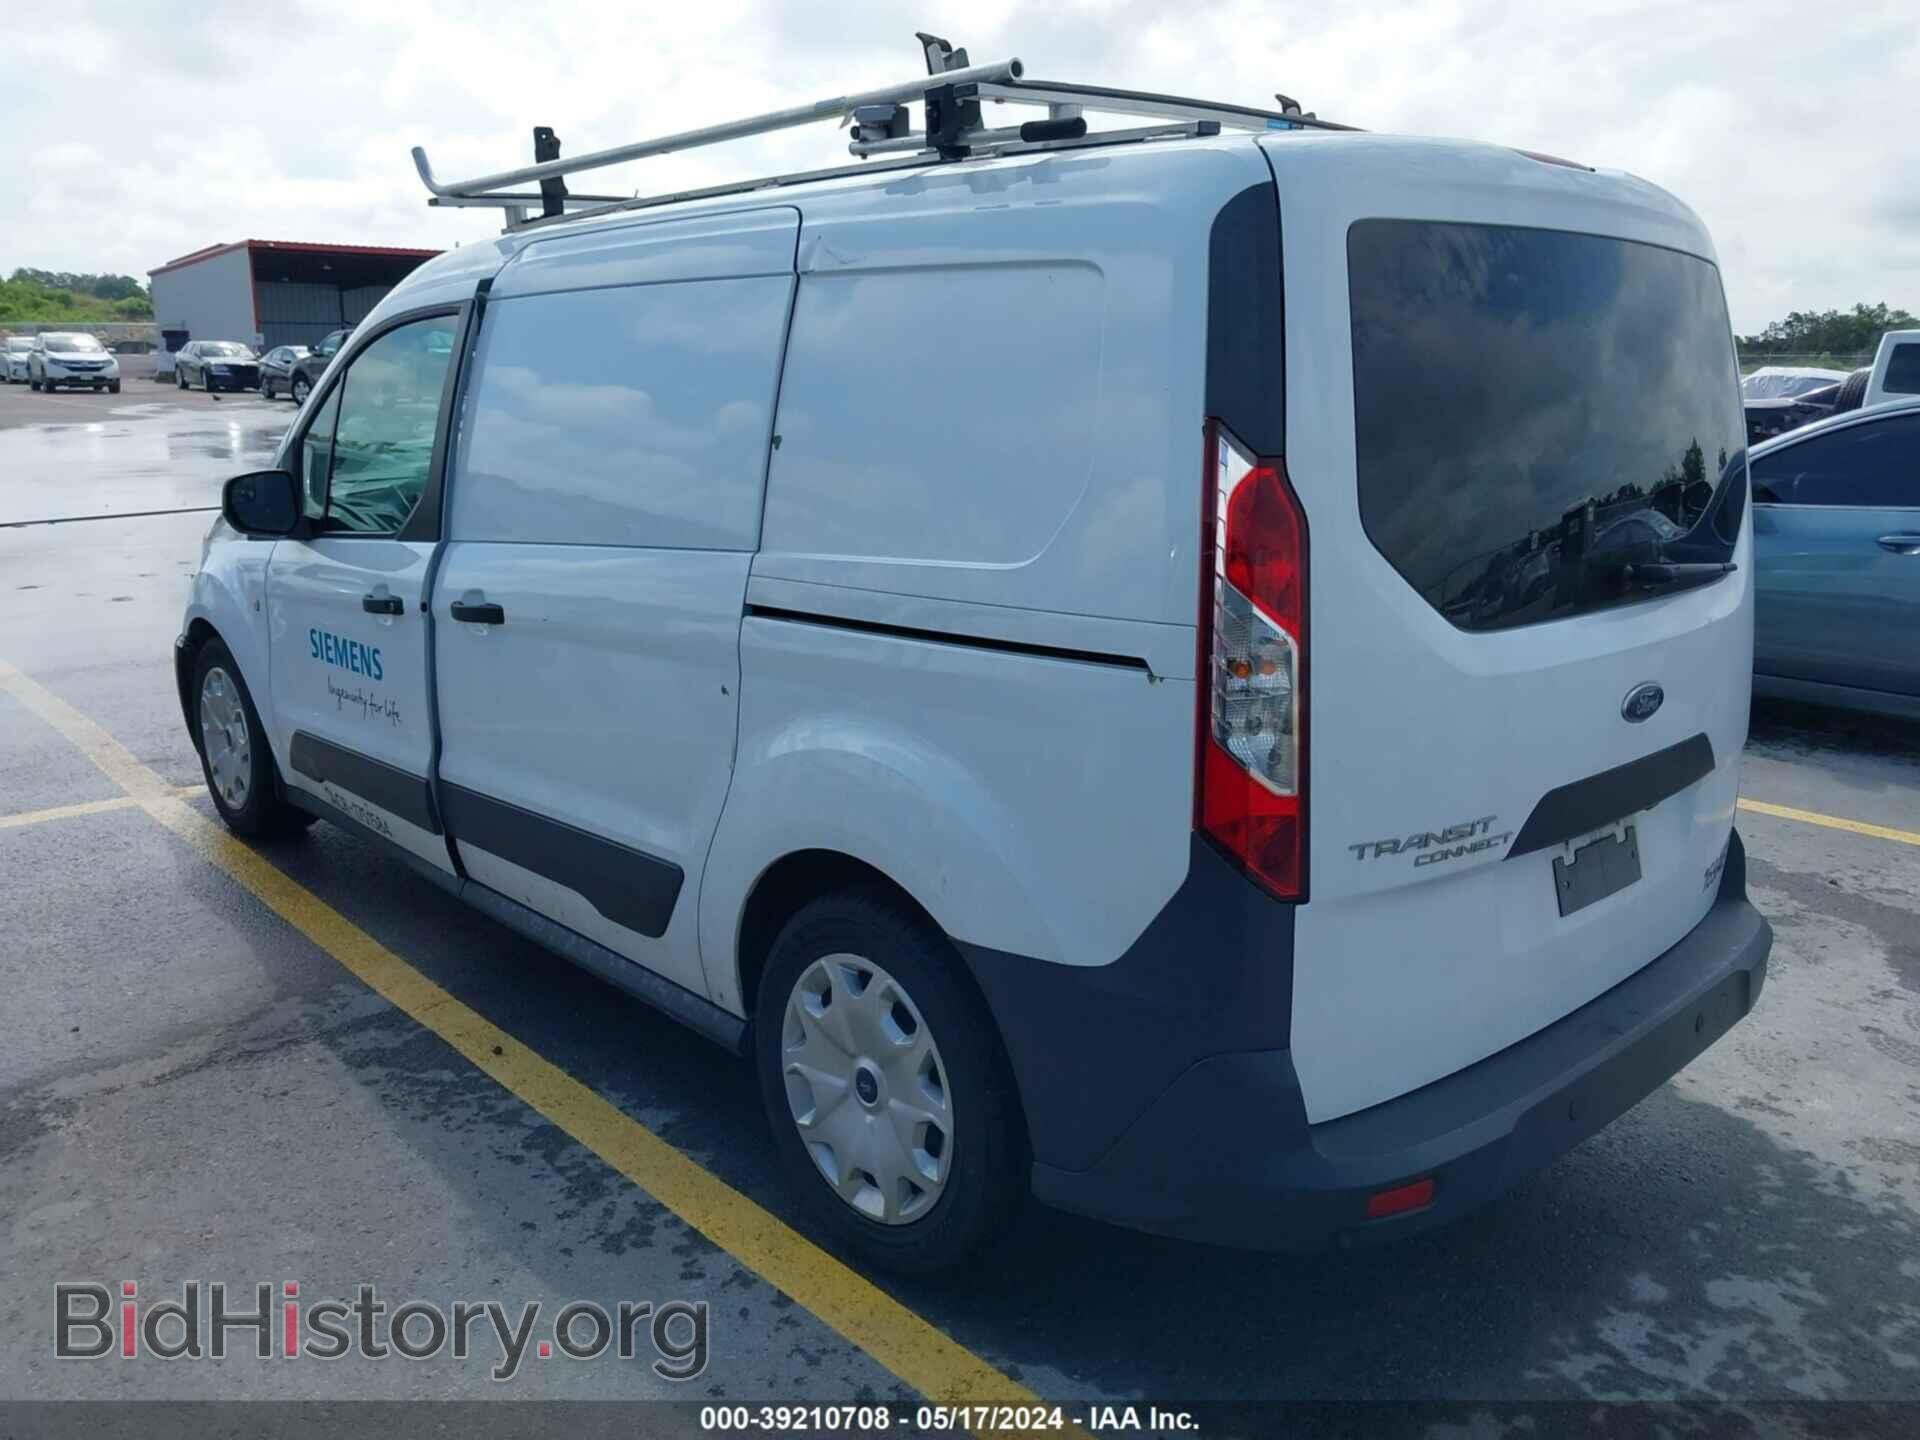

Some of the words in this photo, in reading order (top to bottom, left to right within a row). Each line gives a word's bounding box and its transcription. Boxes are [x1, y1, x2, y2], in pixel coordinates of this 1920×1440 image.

[309, 627, 384, 681] SIEMENS
[1348, 813, 1498, 861] TRANSIT
[1414, 830, 1513, 867] CONNECT
